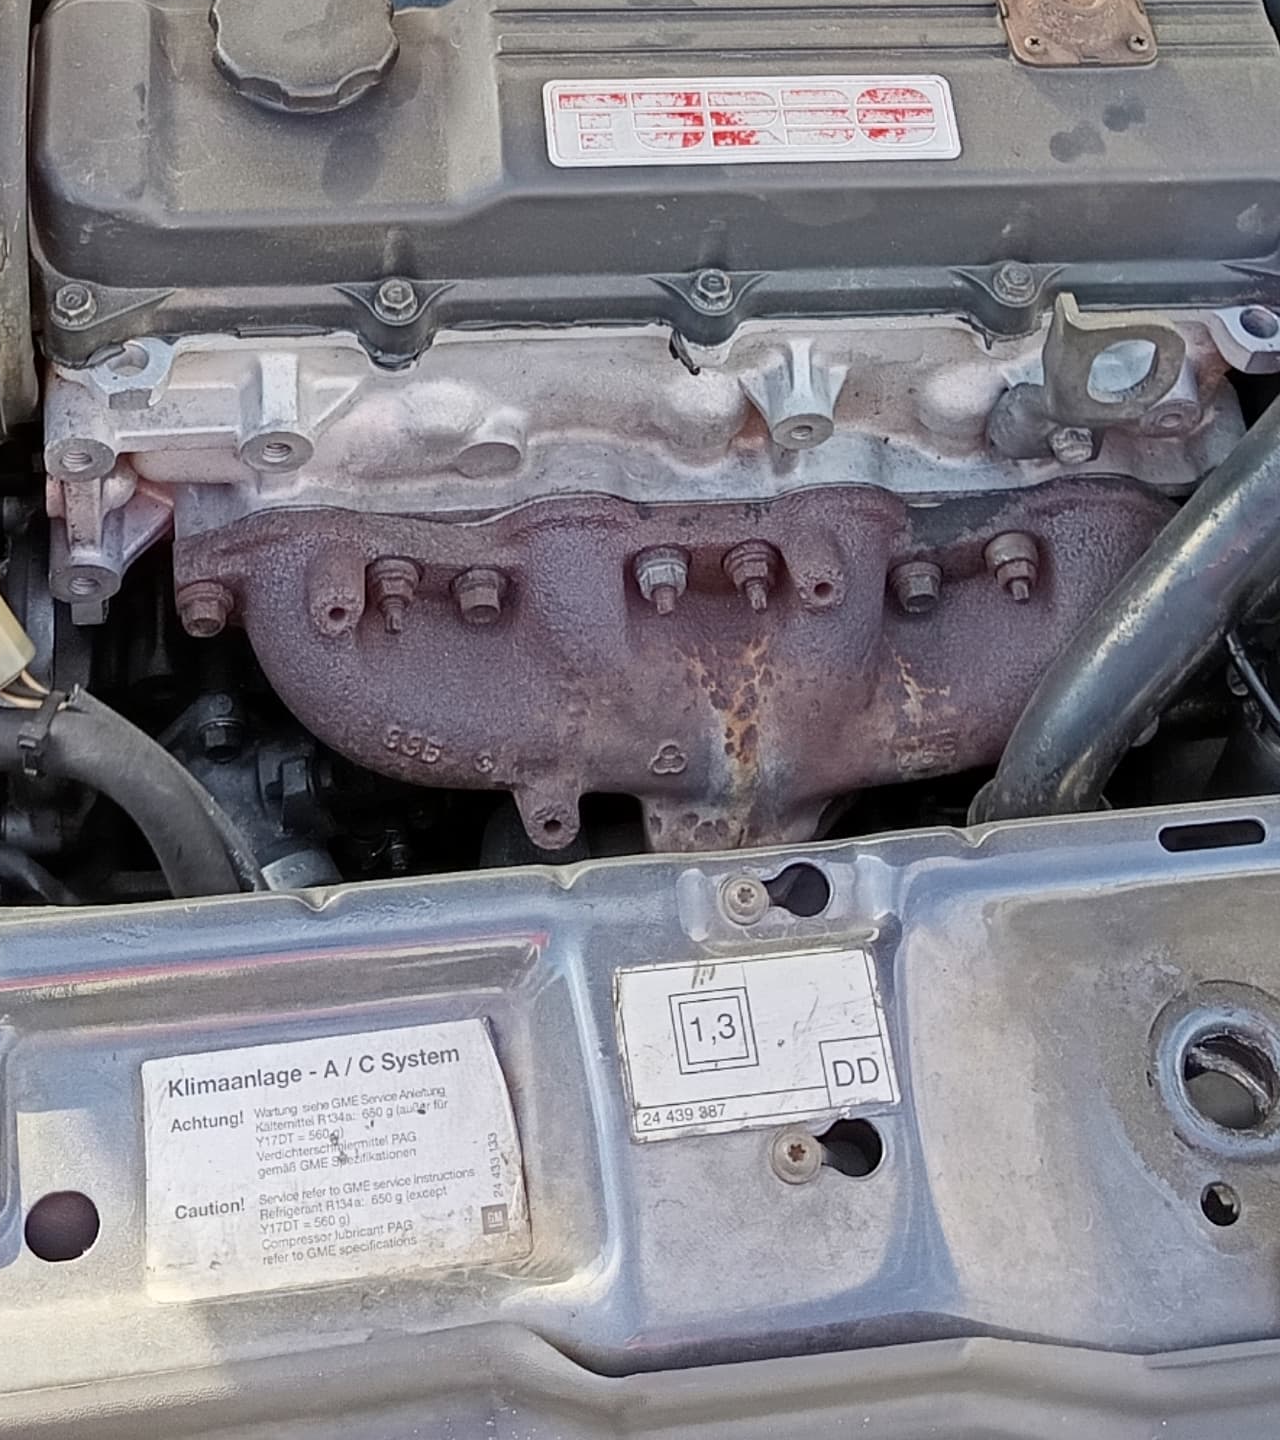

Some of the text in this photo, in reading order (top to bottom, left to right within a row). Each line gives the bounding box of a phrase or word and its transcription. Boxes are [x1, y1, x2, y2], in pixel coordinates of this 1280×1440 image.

[558, 87, 937, 152] TURBO
[689, 1013, 736, 1045] 1,3
[168, 1068, 302, 1098] Klimaanlage
[324, 1060, 339, 1079] A
[345, 1057, 352, 1076] /
[359, 1055, 375, 1073] C
[381, 1048, 460, 1073] System
[832, 1057, 880, 1087] DD
[254, 1106, 297, 1118] Wartung
[331, 1095, 359, 1109] GME
[361, 1093, 397, 1105] Service
[399, 1087, 445, 1100] Anleitung
[386, 1108, 393, 1119] g
[643, 1103, 727, 1126] 24 439 387
[171, 1110, 244, 1133] Achtung!
[256, 1132, 295, 1147] Y17DT
[309, 1128, 329, 1140] 560
[392, 1131, 417, 1144] PAG
[300, 1157, 328, 1171] GME
[259, 1192, 299, 1205] Service
[302, 1187, 326, 1200] refer
[329, 1186, 340, 1196] to
[343, 1180, 370, 1194] GME
[373, 1176, 411, 1190] service
[260, 1202, 322, 1220] Refrigerant
[371, 1192, 392, 1205] 650
[395, 1193, 402, 1205] g
[407, 1186, 447, 1202] (except
[493, 1183, 504, 1198] 24
[175, 1197, 245, 1220] Caution!
[260, 1219, 299, 1235] Y17DT
[314, 1215, 335, 1228] 560
[339, 1213, 350, 1227] g)
[262, 1220, 413, 1250] Compressor lubricant PAG
[263, 1236, 417, 1265] refer to GME specifications
